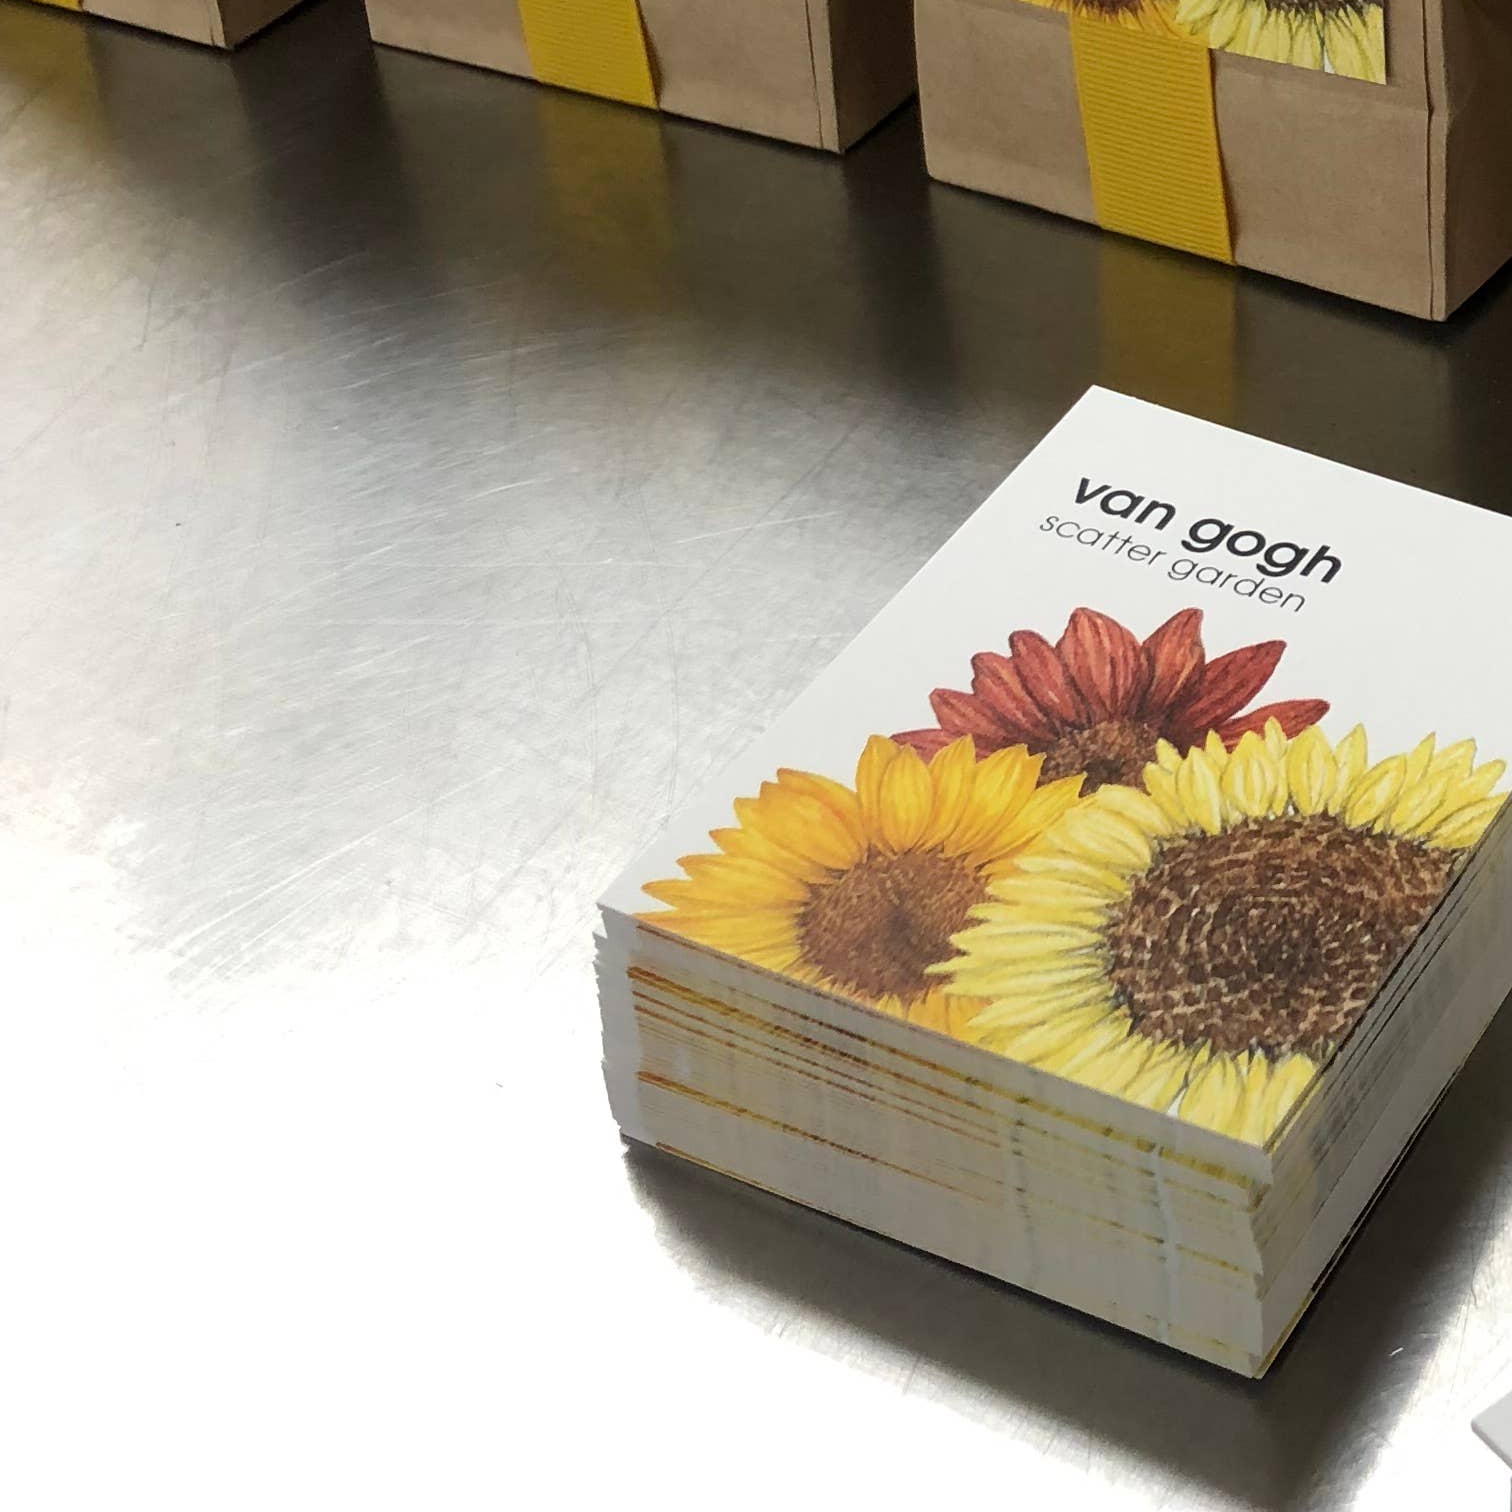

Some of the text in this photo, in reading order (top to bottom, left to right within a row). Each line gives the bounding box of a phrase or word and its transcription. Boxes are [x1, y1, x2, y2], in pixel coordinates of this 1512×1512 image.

[1039, 515, 1306, 613] scatter garden
[1074, 476, 1342, 585] van gogh
